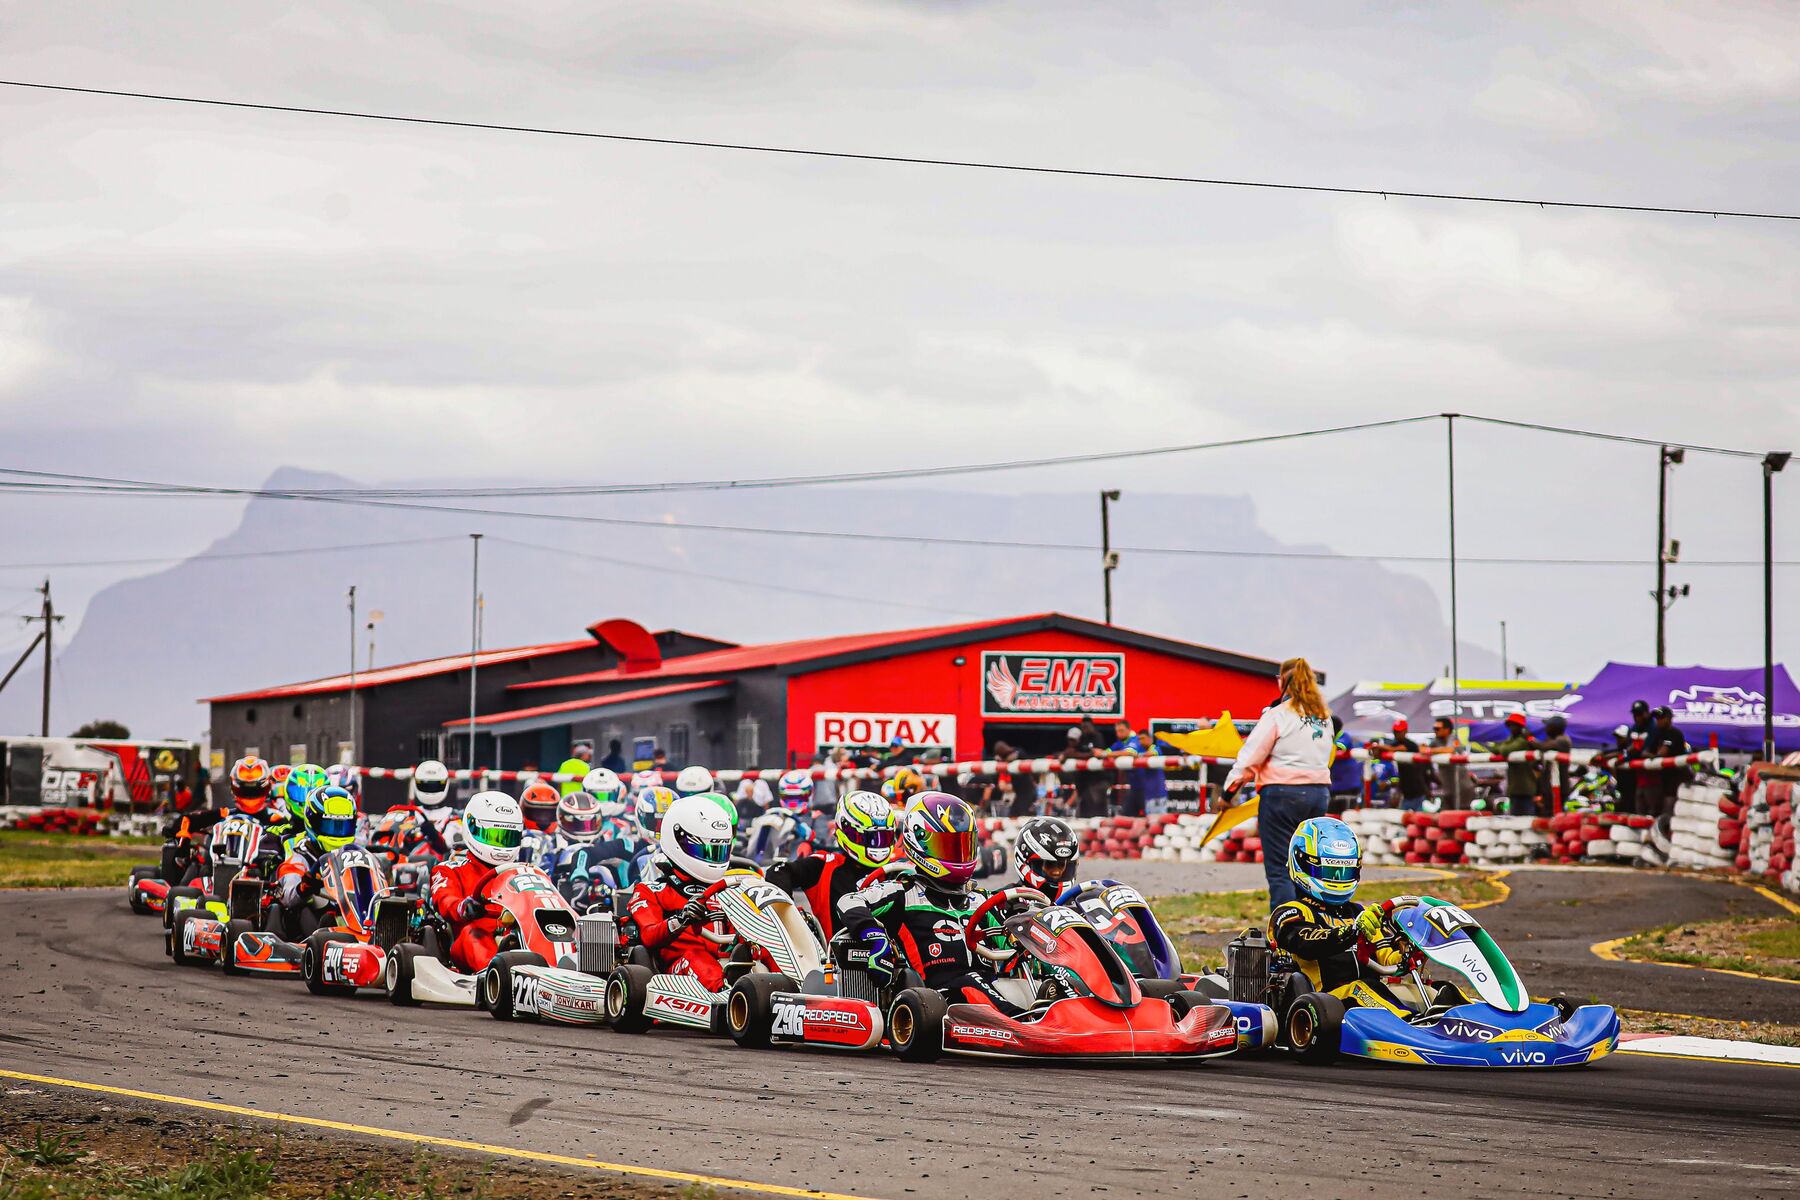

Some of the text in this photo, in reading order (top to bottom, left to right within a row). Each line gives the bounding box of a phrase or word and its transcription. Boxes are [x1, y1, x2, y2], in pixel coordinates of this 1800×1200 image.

[1019, 658, 1118, 694] EMR
[1016, 695, 1117, 711] KARTSPORT
[824, 719, 941, 744] ROTAX
[1462, 954, 1488, 983] vivo
[655, 995, 710, 1015] KSM
[771, 1003, 806, 1035] 296
[804, 1009, 858, 1025] REDSPEED
[952, 1025, 1012, 1040] REDSPEED
[1443, 1021, 1494, 1040] vivo
[1501, 1049, 1546, 1064] vivo
